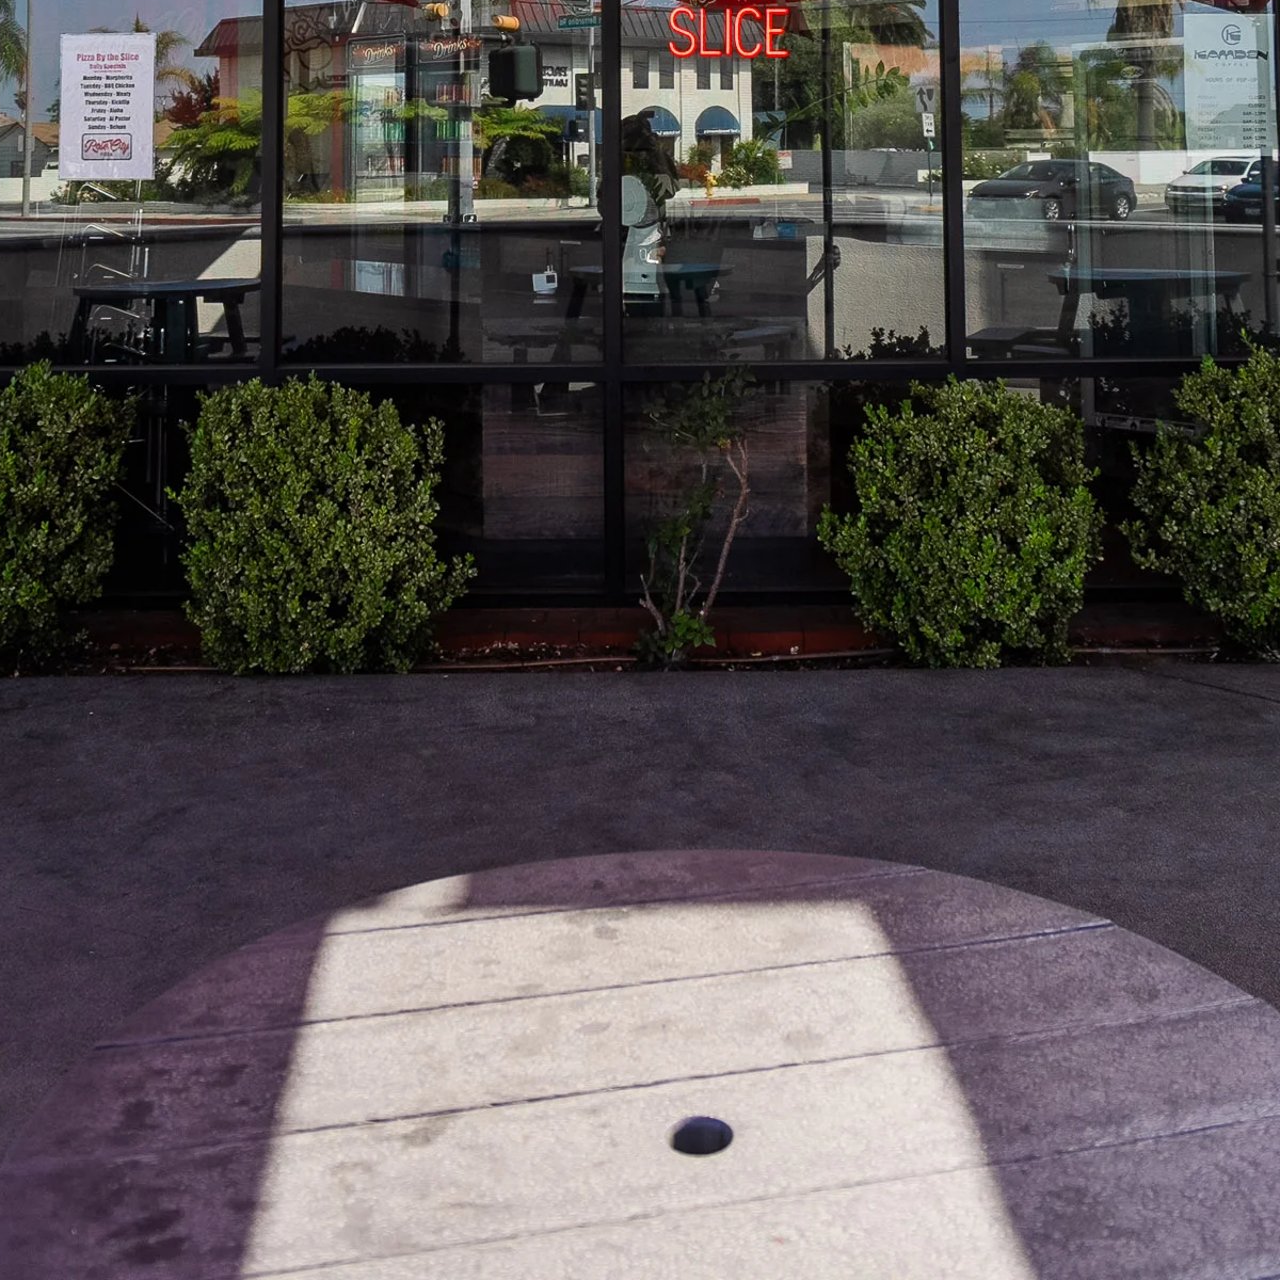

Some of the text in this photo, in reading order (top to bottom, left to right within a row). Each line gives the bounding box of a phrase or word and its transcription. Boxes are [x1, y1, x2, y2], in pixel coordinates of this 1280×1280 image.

[668, 6, 790, 58] SLICE
[76, 52, 139, 62] Pizza By the Slice
[364, 43, 394, 64] Drinks
[433, 38, 467, 60] Drinks
[110, 138, 130, 155] City
